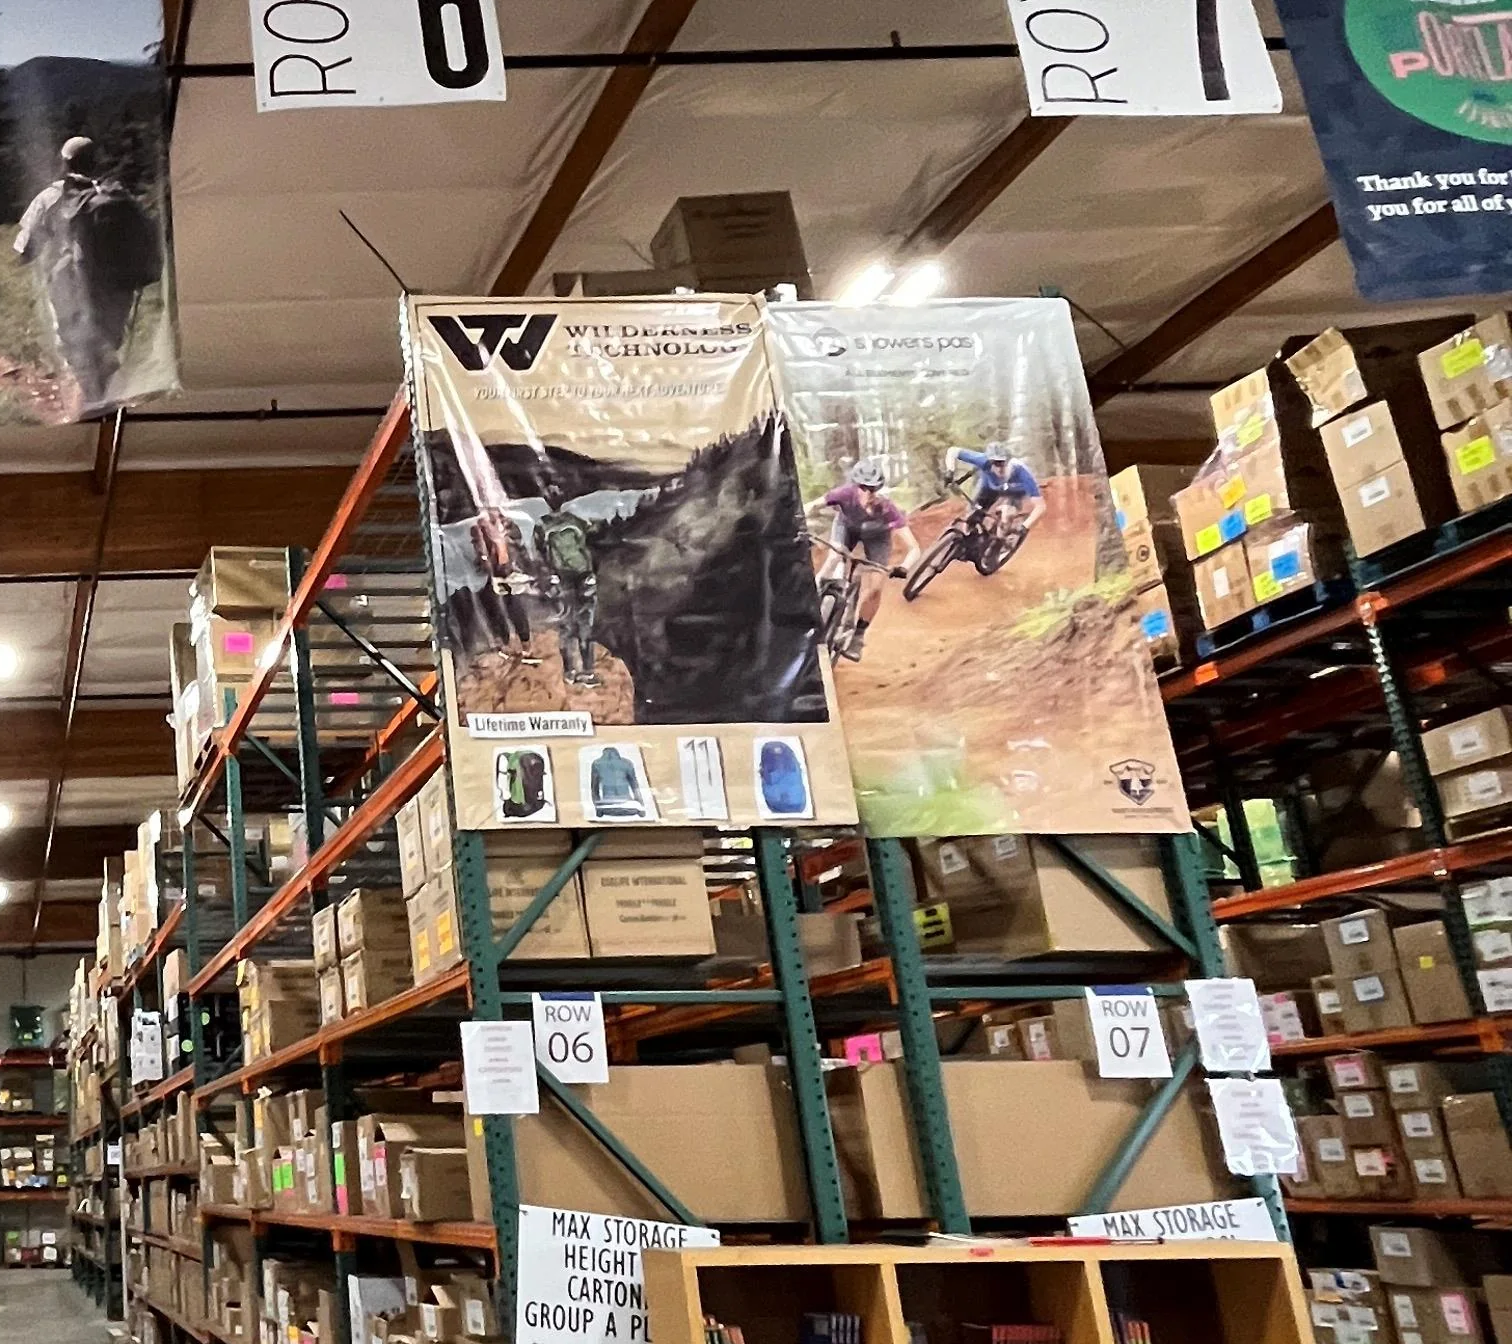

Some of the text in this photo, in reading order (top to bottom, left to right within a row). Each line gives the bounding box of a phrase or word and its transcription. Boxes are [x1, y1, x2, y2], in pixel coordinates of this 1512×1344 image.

[1357, 168, 1508, 192] Thank you for
[1367, 193, 1505, 221] you for all of
[475, 716, 587, 732] Lifetime Warranty
[545, 1005, 591, 1022] ROW
[1102, 1000, 1148, 1018] ROW
[548, 1032, 593, 1063] 06
[1109, 1027, 1151, 1058] 07
[552, 1211, 591, 1240] MAX
[1102, 1203, 1241, 1237] MAX STORAGE
[564, 1244, 638, 1277] HEIGHT
[568, 1275, 649, 1310] CARTON
[525, 1301, 594, 1334] GROUP
[605, 1312, 617, 1338] A
